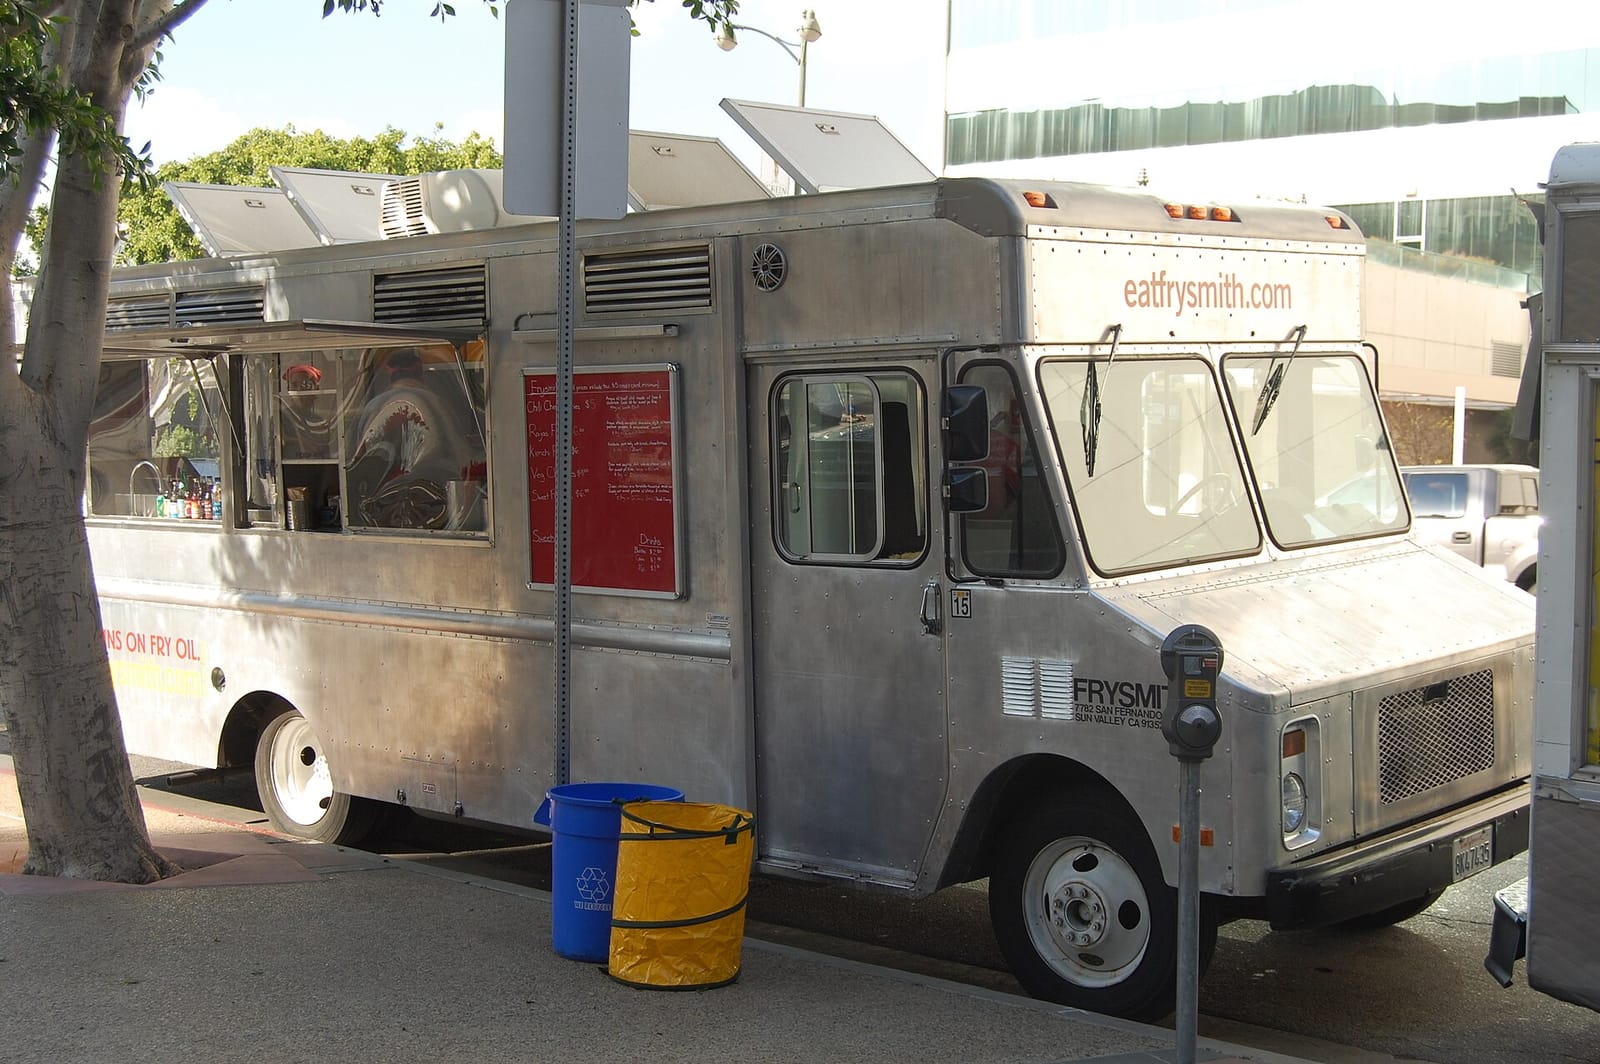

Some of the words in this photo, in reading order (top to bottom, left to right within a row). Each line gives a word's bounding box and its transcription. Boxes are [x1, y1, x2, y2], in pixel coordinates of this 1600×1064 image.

[1124, 270, 1292, 317] eatfrysmith.com
[954, 597, 969, 615] 15
[102, 629, 123, 651] NS
[126, 631, 146, 654] ON
[150, 634, 171, 657] FRY
[175, 638, 201, 661] OIL.
[1073, 677, 1168, 710] FRYSMI
[1074, 703, 1094, 713] 7782
[1095, 705, 1113, 715] SAN
[1115, 706, 1163, 720] FERNANDO
[1075, 712, 1093, 723] SUN
[1094, 714, 1126, 727] VALLEY
[1128, 717, 1141, 728] CA
